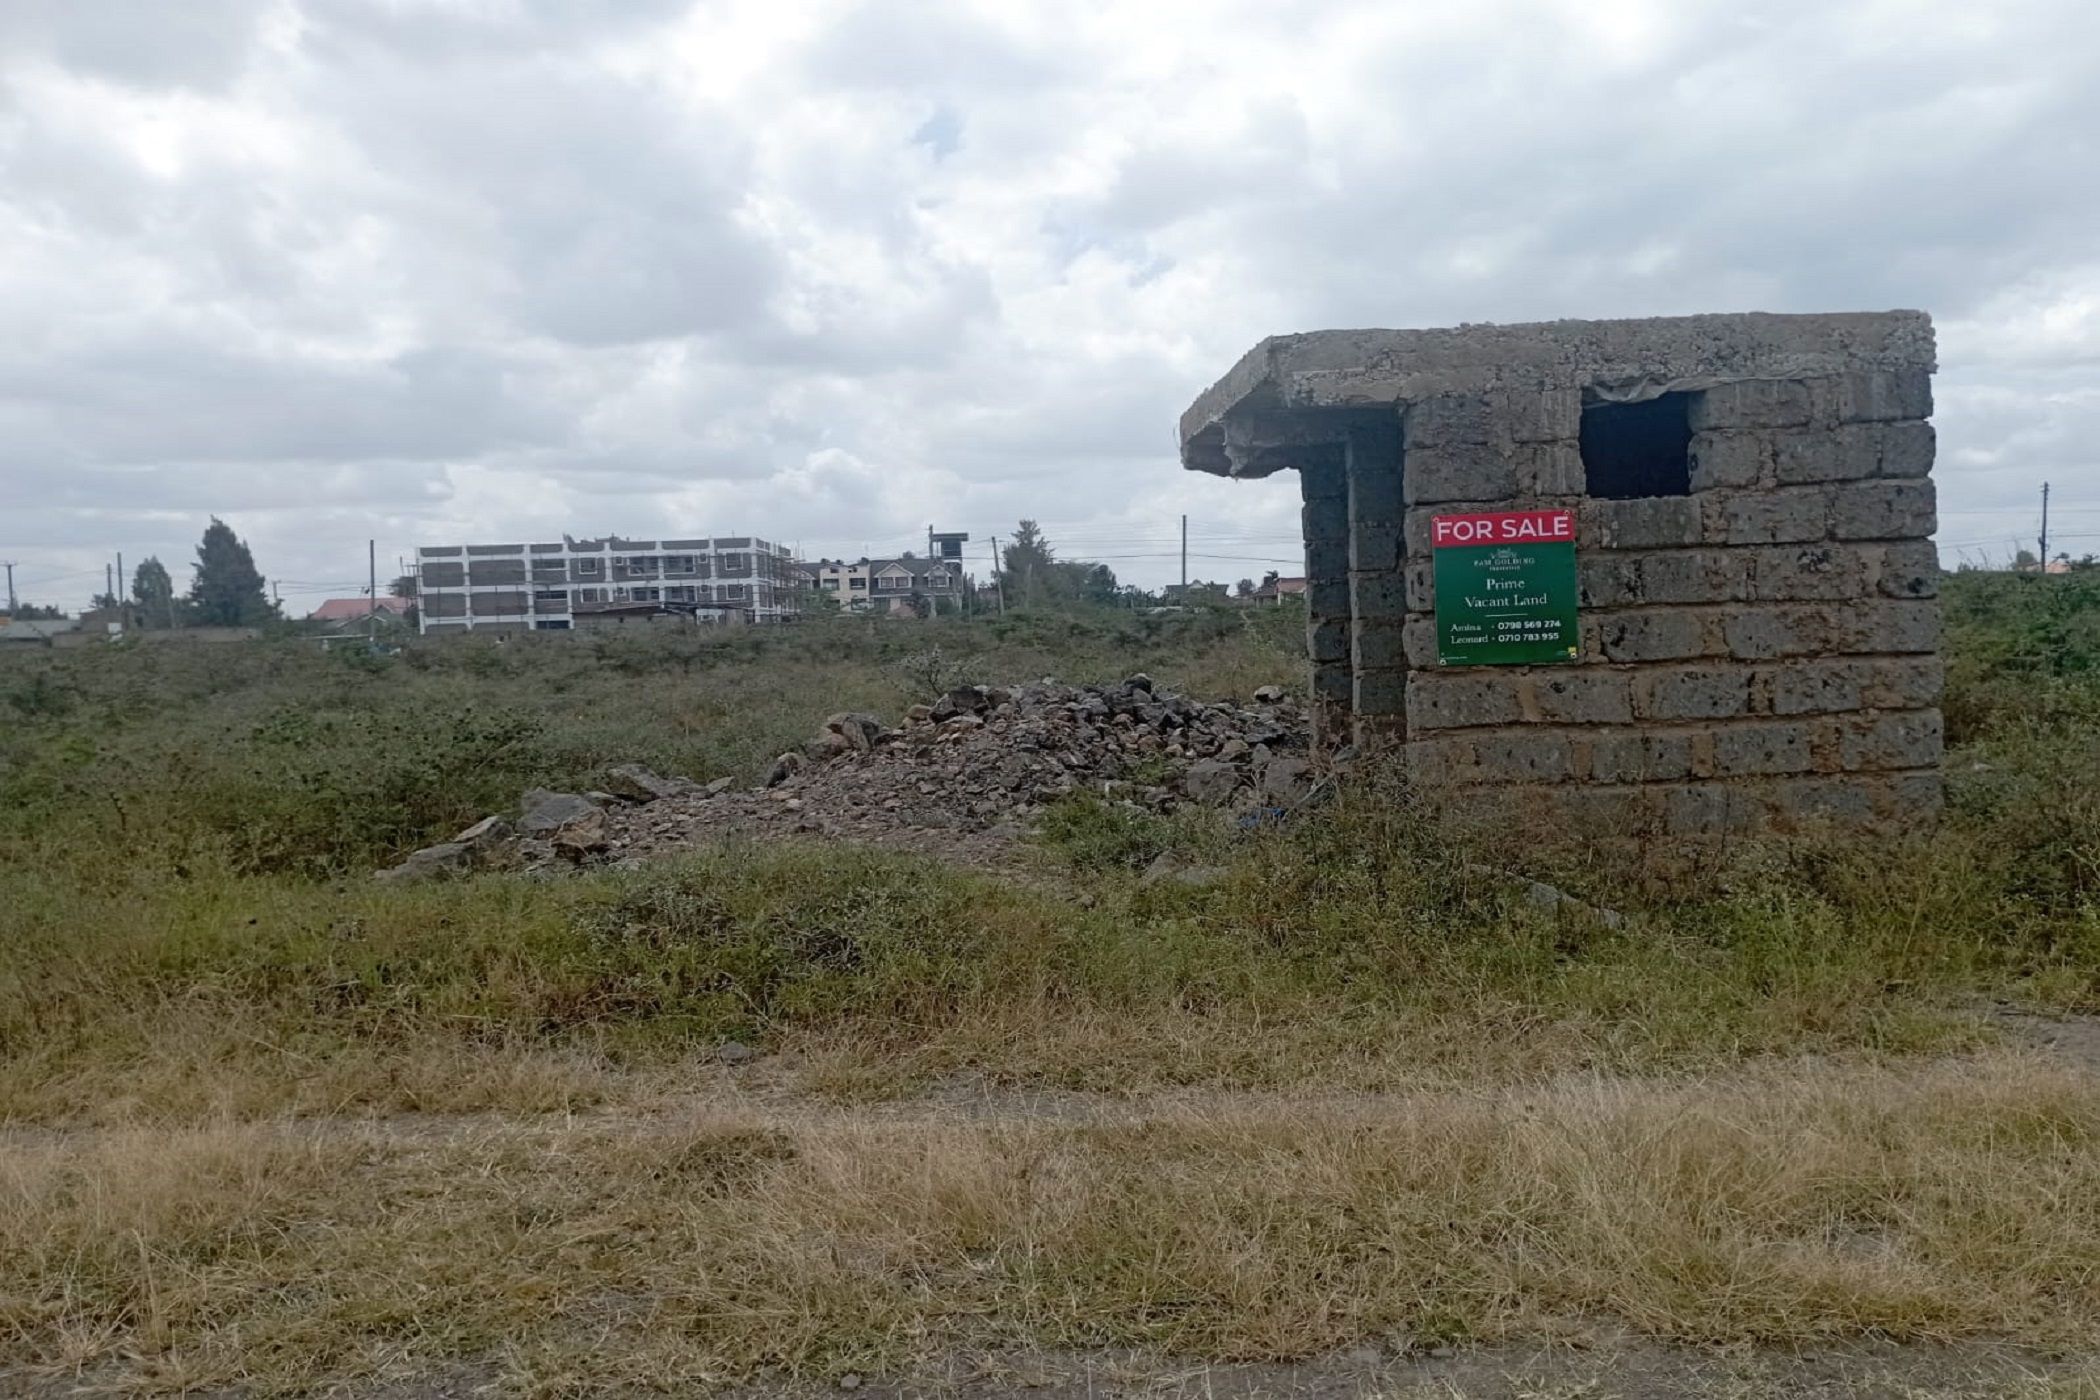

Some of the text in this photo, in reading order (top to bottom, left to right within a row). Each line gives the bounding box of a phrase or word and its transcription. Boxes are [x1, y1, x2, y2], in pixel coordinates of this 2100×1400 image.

[1438, 516, 1569, 542] FOR SALE
[1486, 578, 1526, 591] Prime
[1465, 593, 1548, 608] Vacant Land
[1544, 620, 1561, 628] 274
[1451, 632, 1560, 644] Leonard 0710 783 955
